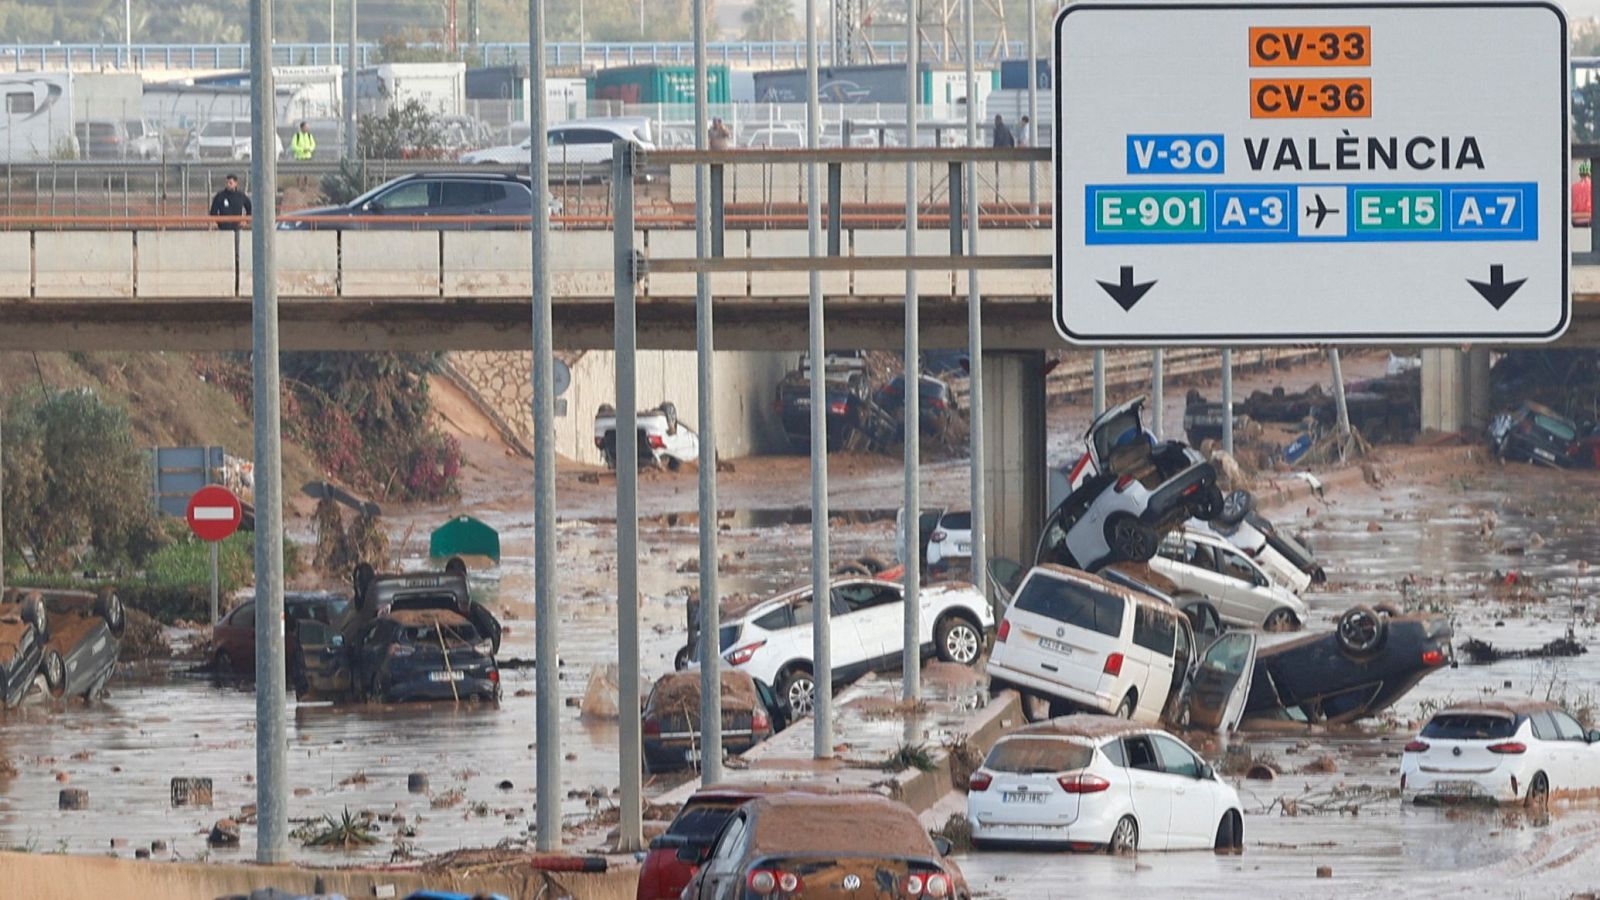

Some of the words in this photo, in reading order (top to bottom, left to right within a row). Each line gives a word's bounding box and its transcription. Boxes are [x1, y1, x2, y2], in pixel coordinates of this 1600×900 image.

[1256, 33, 1365, 61] CV-33
[1257, 85, 1365, 112] CV-36
[1134, 140, 1219, 168] V-30
[1244, 129, 1485, 170] VALÈNCIA
[1102, 197, 1201, 226] E-901
[1222, 197, 1283, 225] A-3
[1361, 196, 1435, 224] E-15
[1458, 196, 1516, 224] A-7
